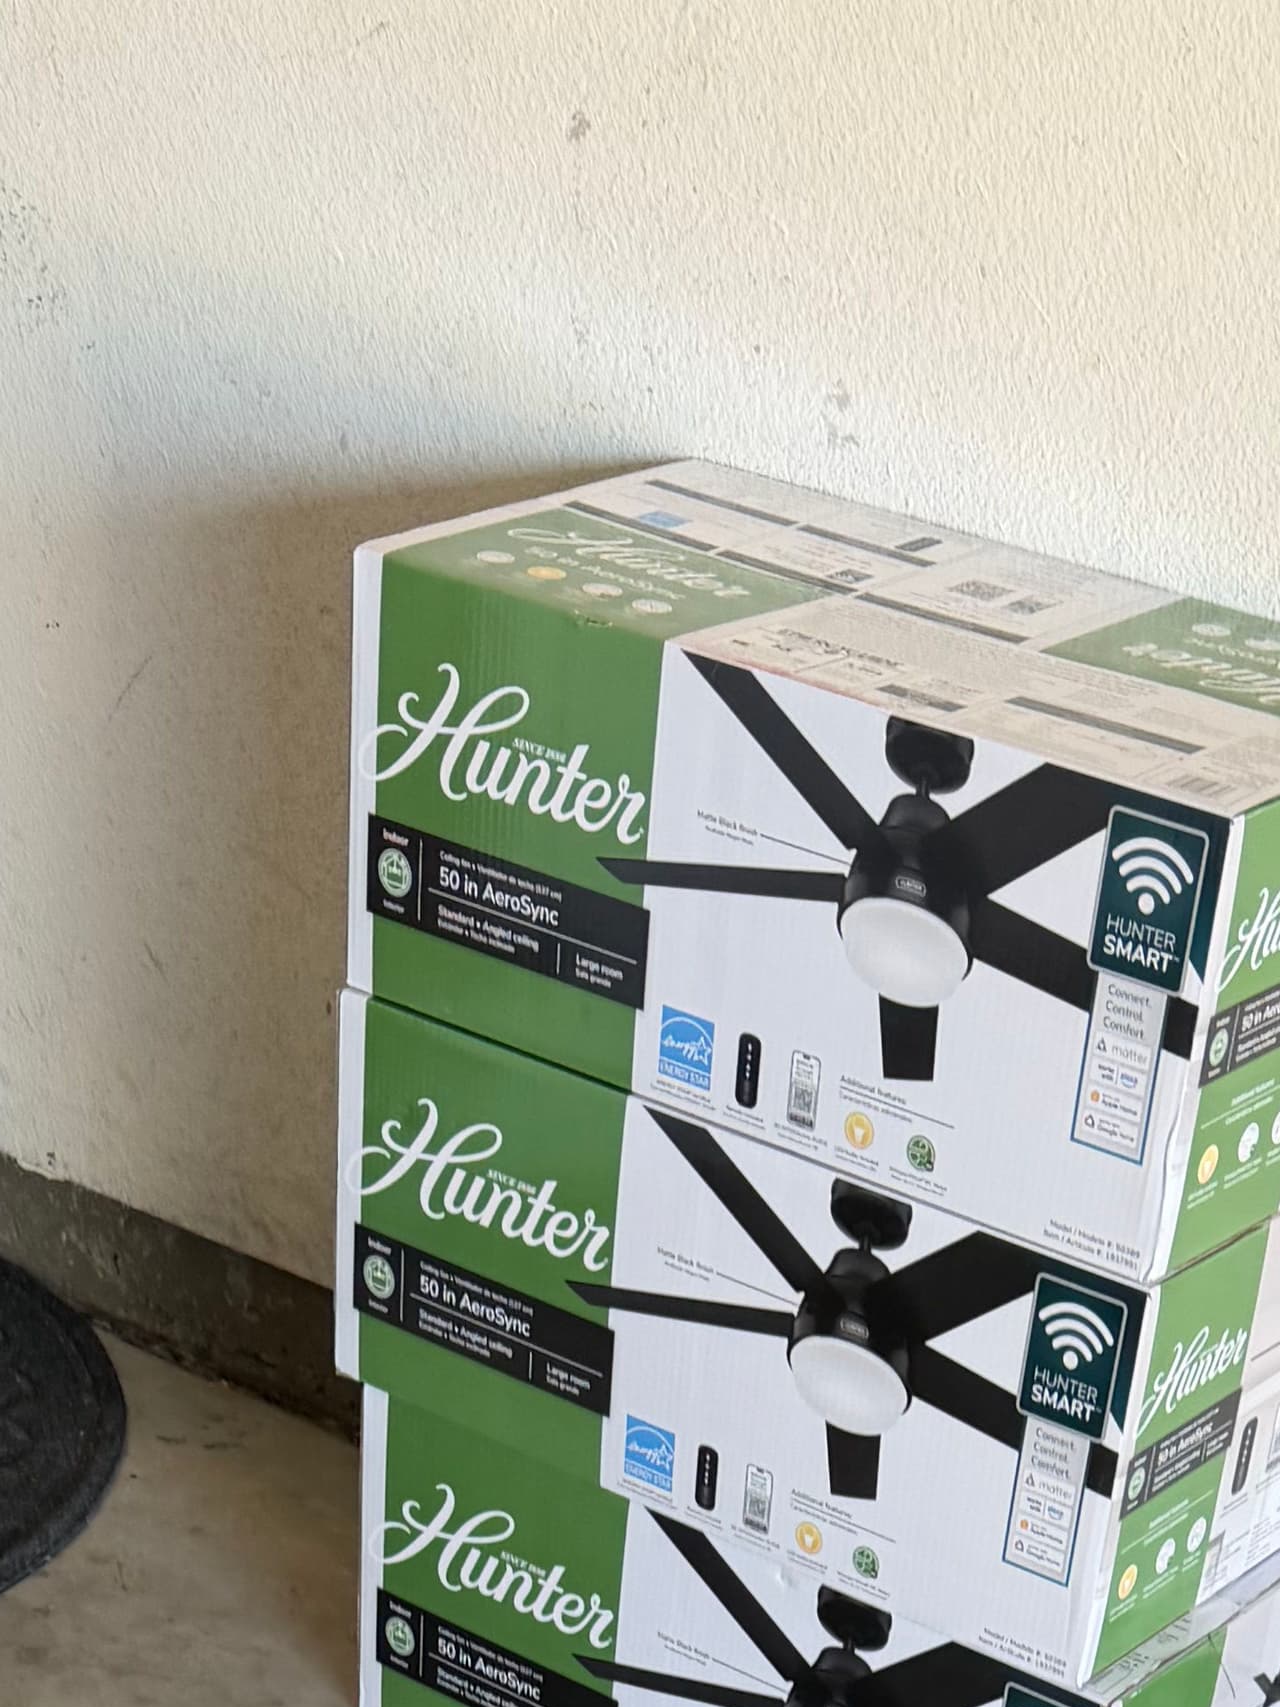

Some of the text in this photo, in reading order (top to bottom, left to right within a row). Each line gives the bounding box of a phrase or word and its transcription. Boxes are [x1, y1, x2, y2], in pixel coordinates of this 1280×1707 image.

[358, 662, 645, 844] Hunter
[511, 734, 544, 757] SINCE
[439, 864, 559, 930] 50 in AeroSync
[438, 904, 539, 953] Standard Angled ceiling
[1105, 911, 1176, 953] HUNTER
[575, 953, 622, 982] Large room
[659, 1059, 709, 1089] ENERGY STAR
[1110, 1041, 1148, 1066] matter
[344, 1098, 610, 1272] Hunter
[419, 1274, 531, 1341] 50 in AeroSync
[1033, 1364, 1098, 1405] HUNTER
[1136, 1326, 1247, 1438] Hunter
[625, 1461, 671, 1491] ENERGY STAR
[1038, 1478, 1073, 1502] matter
[369, 1483, 614, 1649] Hunter
[437, 1636, 455, 1660] 50
[459, 1647, 471, 1667] in
[475, 1654, 541, 1703] AeroSync
